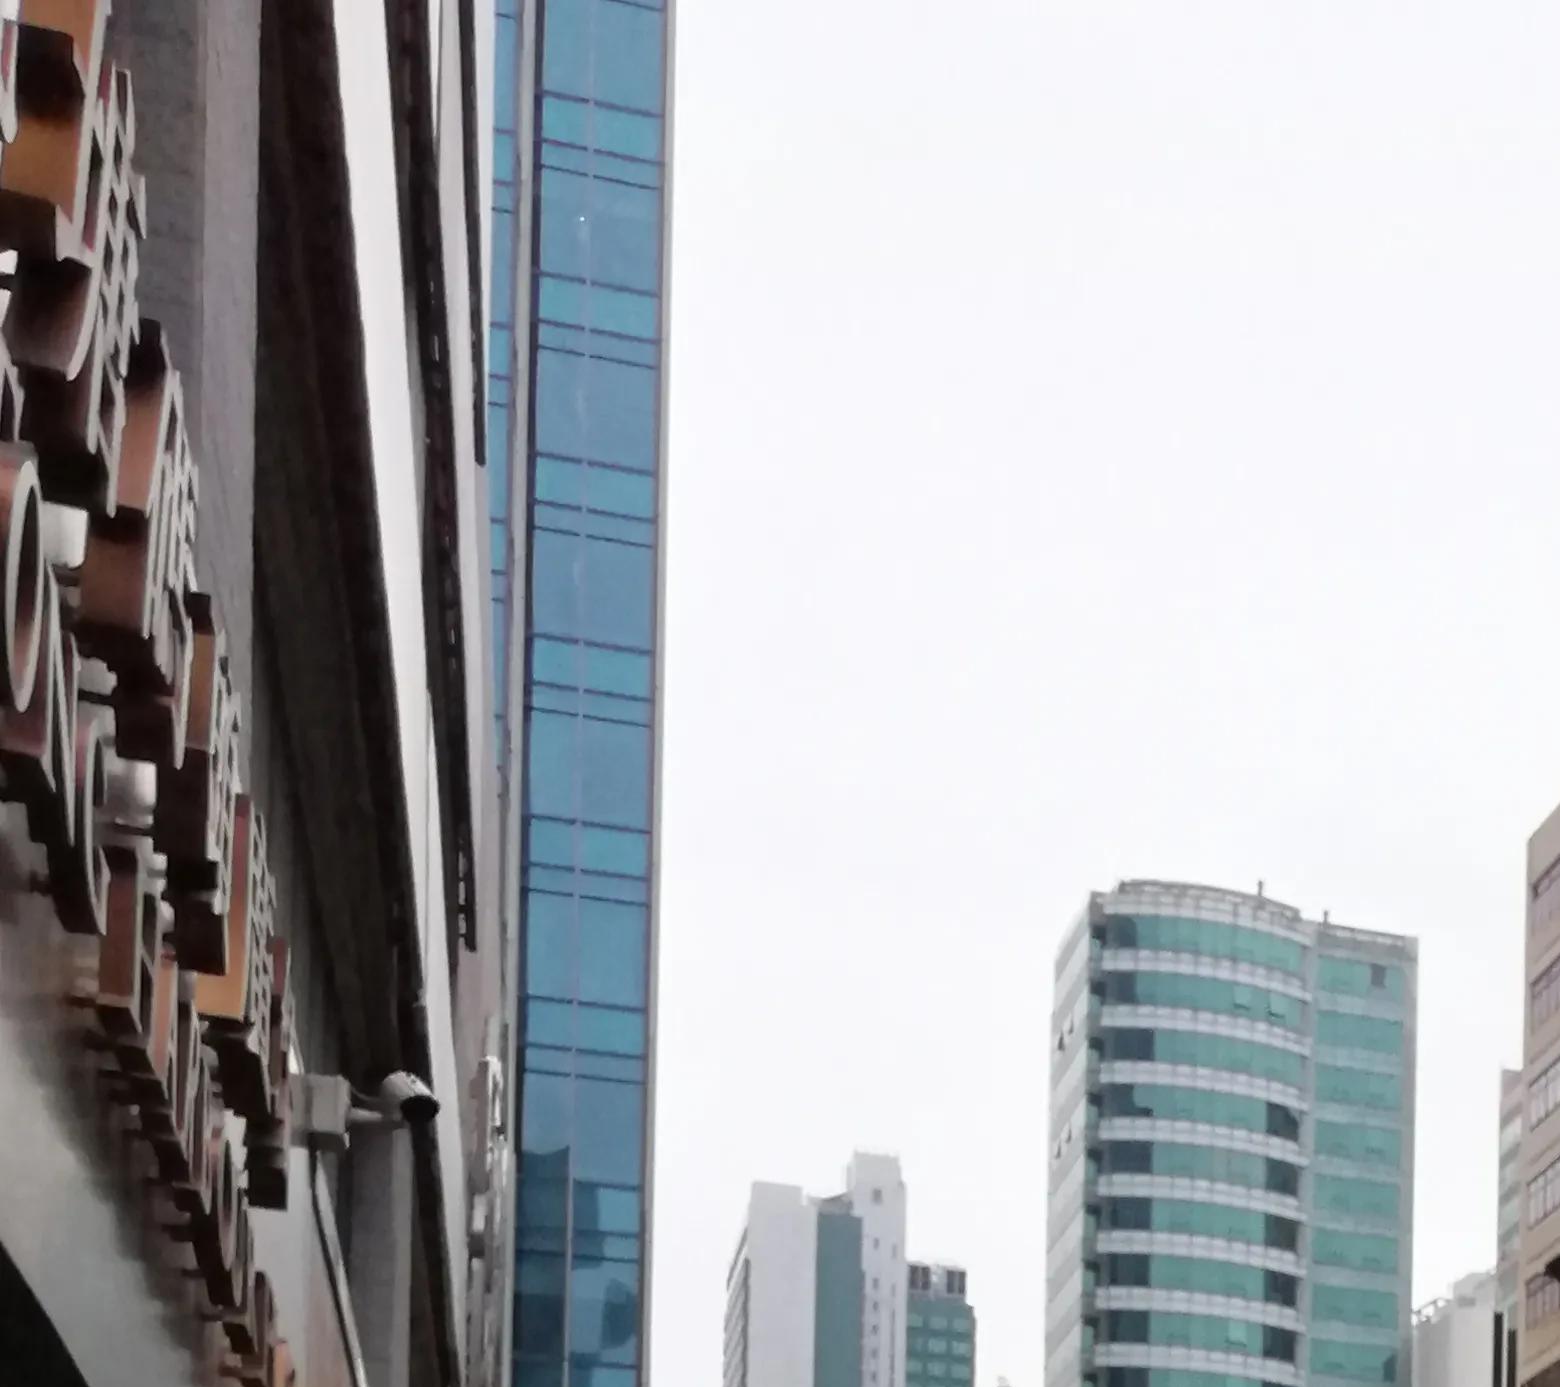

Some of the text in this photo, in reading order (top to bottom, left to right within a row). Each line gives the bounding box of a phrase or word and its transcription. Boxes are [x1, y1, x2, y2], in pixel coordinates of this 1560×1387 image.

[0, 0, 304, 1165] 塘碼頭廣場
